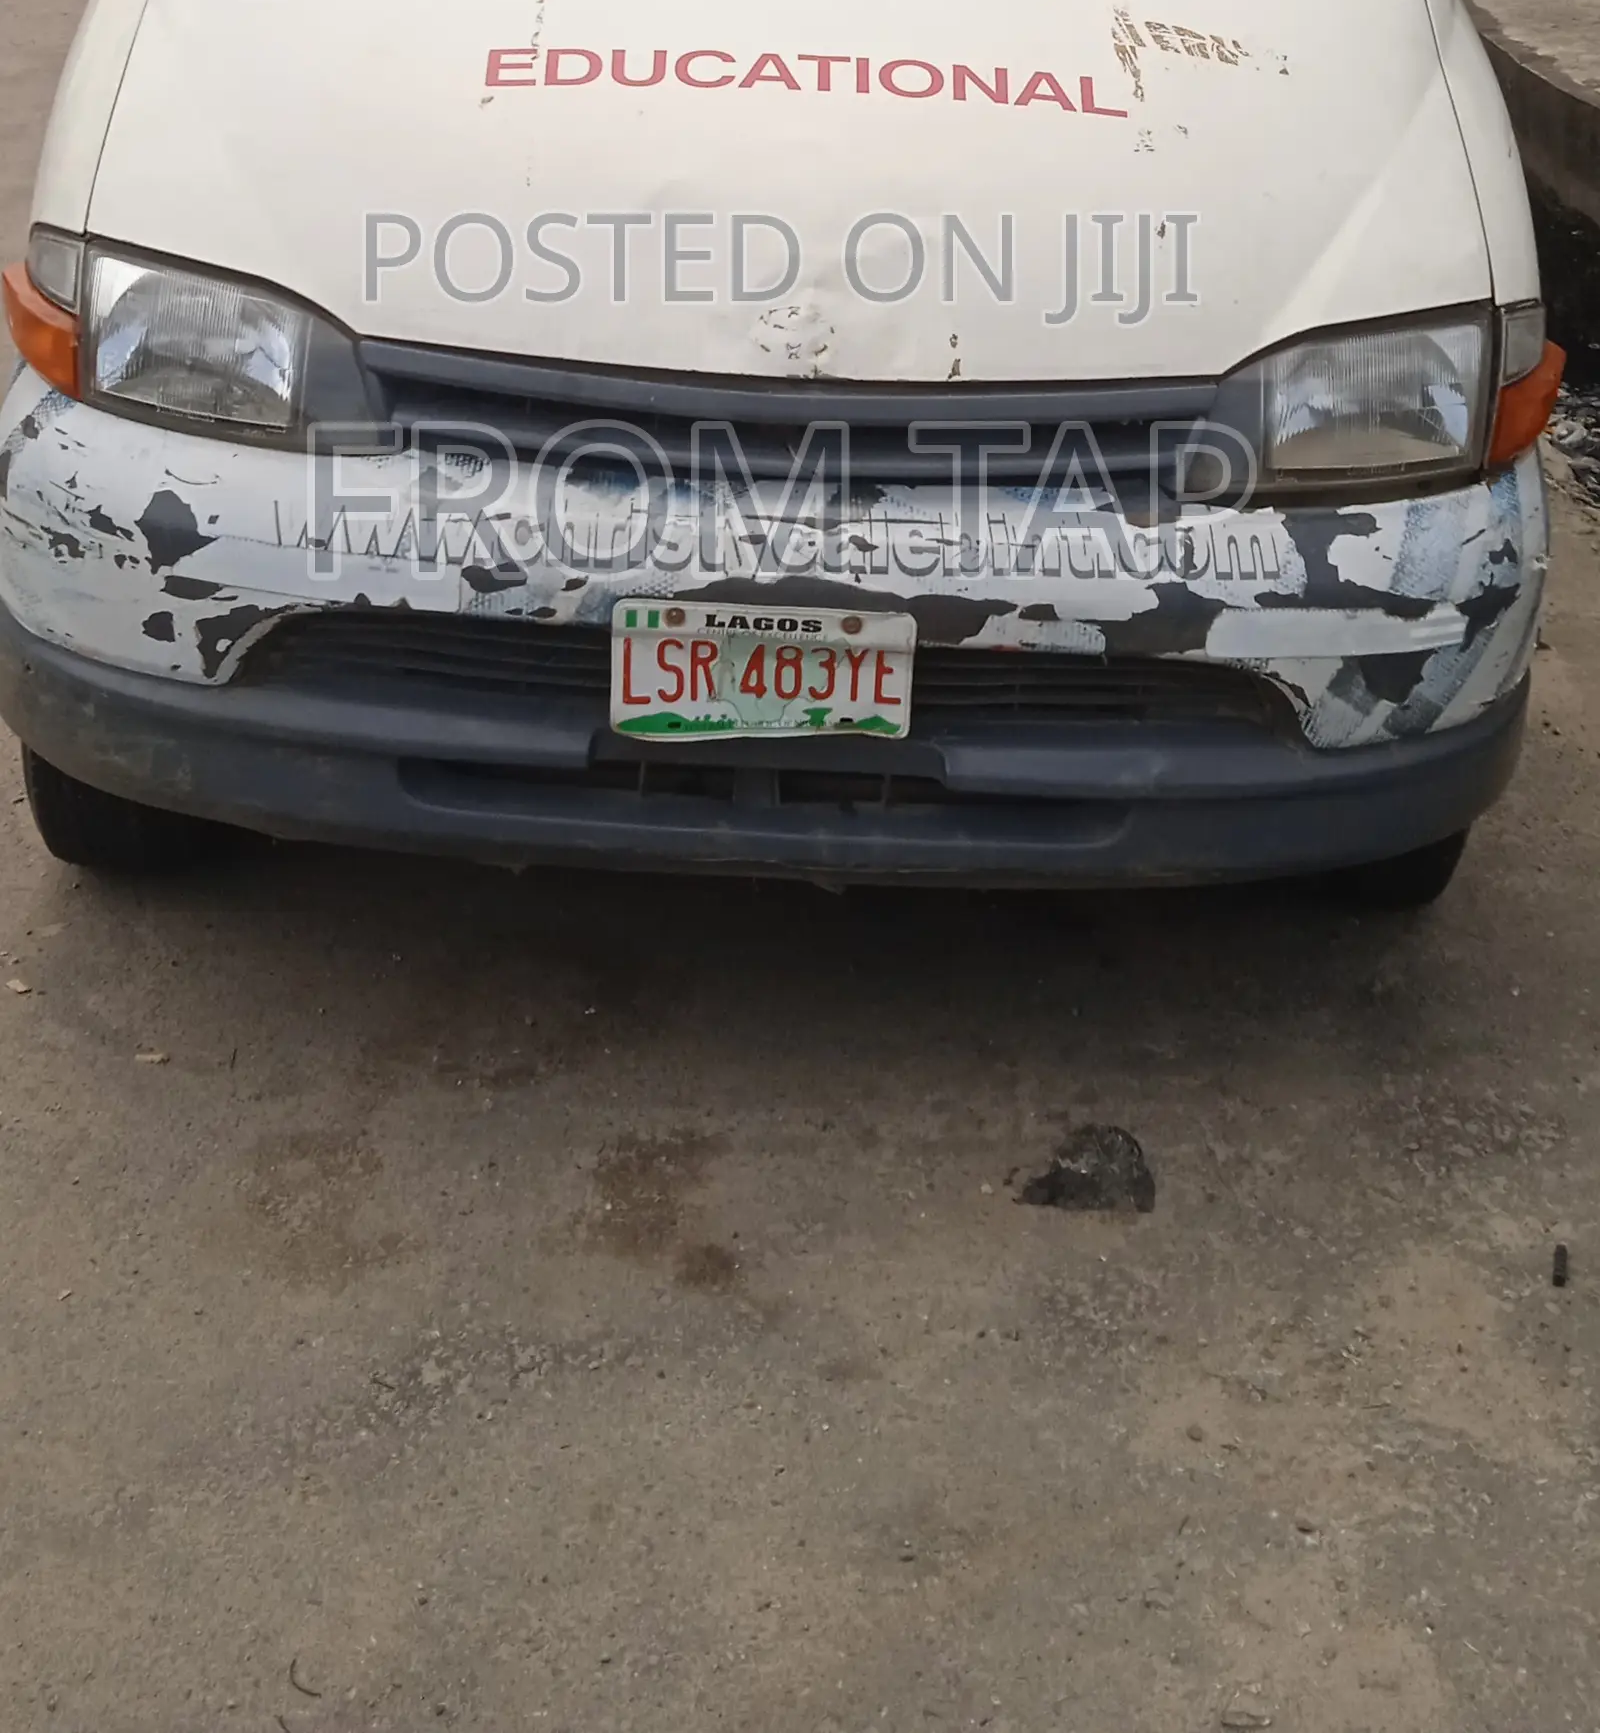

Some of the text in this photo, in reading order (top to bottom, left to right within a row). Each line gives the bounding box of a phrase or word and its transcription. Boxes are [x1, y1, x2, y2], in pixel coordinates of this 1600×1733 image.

[484, 49, 1128, 118] EDUCATIONAL
[705, 614, 822, 632] LAGOS
[622, 636, 901, 704] LSR 483YE
